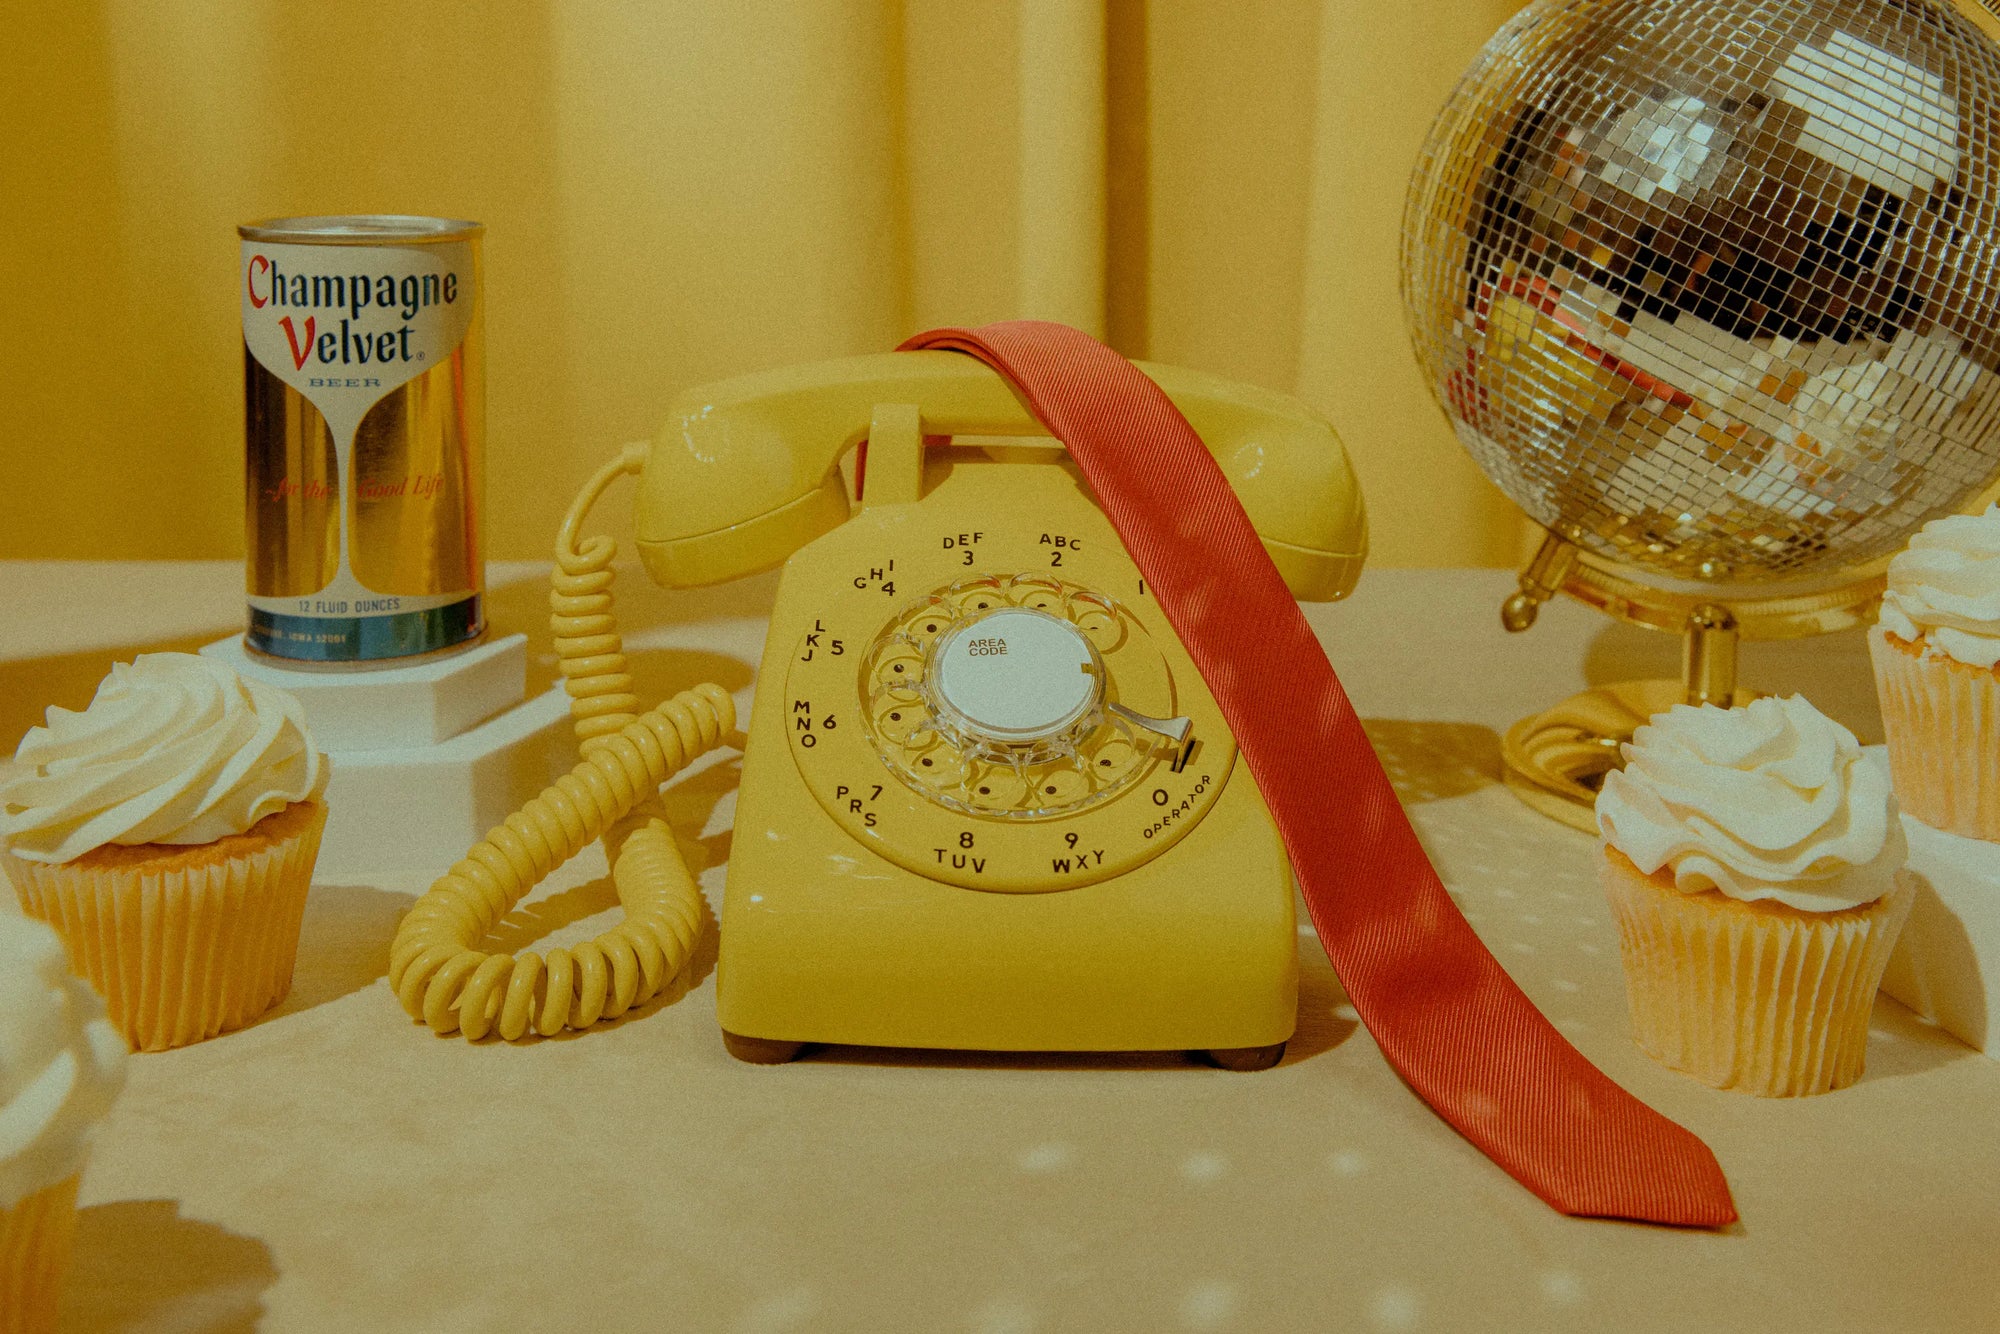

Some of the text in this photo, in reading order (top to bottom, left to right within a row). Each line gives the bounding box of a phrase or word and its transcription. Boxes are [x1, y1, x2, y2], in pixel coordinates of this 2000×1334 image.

[248, 254, 458, 321] Champagne
[278, 315, 416, 372] Velvet
[308, 378, 381, 388] BEER
[303, 479, 333, 500] the
[357, 476, 409, 500] Good
[412, 473, 444, 501] Life
[942, 532, 984, 549] DEF
[1038, 533, 1082, 551] ABC
[962, 550, 974, 566] 3
[1050, 551, 1063, 567] 2
[853, 559, 895, 590] GHI
[880, 581, 896, 597] 4
[299, 598, 401, 614] 12 FLUID OUNCES
[830, 639, 845, 656] 5
[968, 638, 1007, 648] AREA
[969, 646, 1008, 657] CODE
[822, 714, 837, 730] 6
[869, 785, 883, 801] 7
[1143, 774, 1211, 840] OPERATOR
[959, 831, 974, 849] 8
[1064, 832, 1079, 850] 9
[933, 848, 986, 874] TUV
[1052, 849, 1106, 874] WXY
